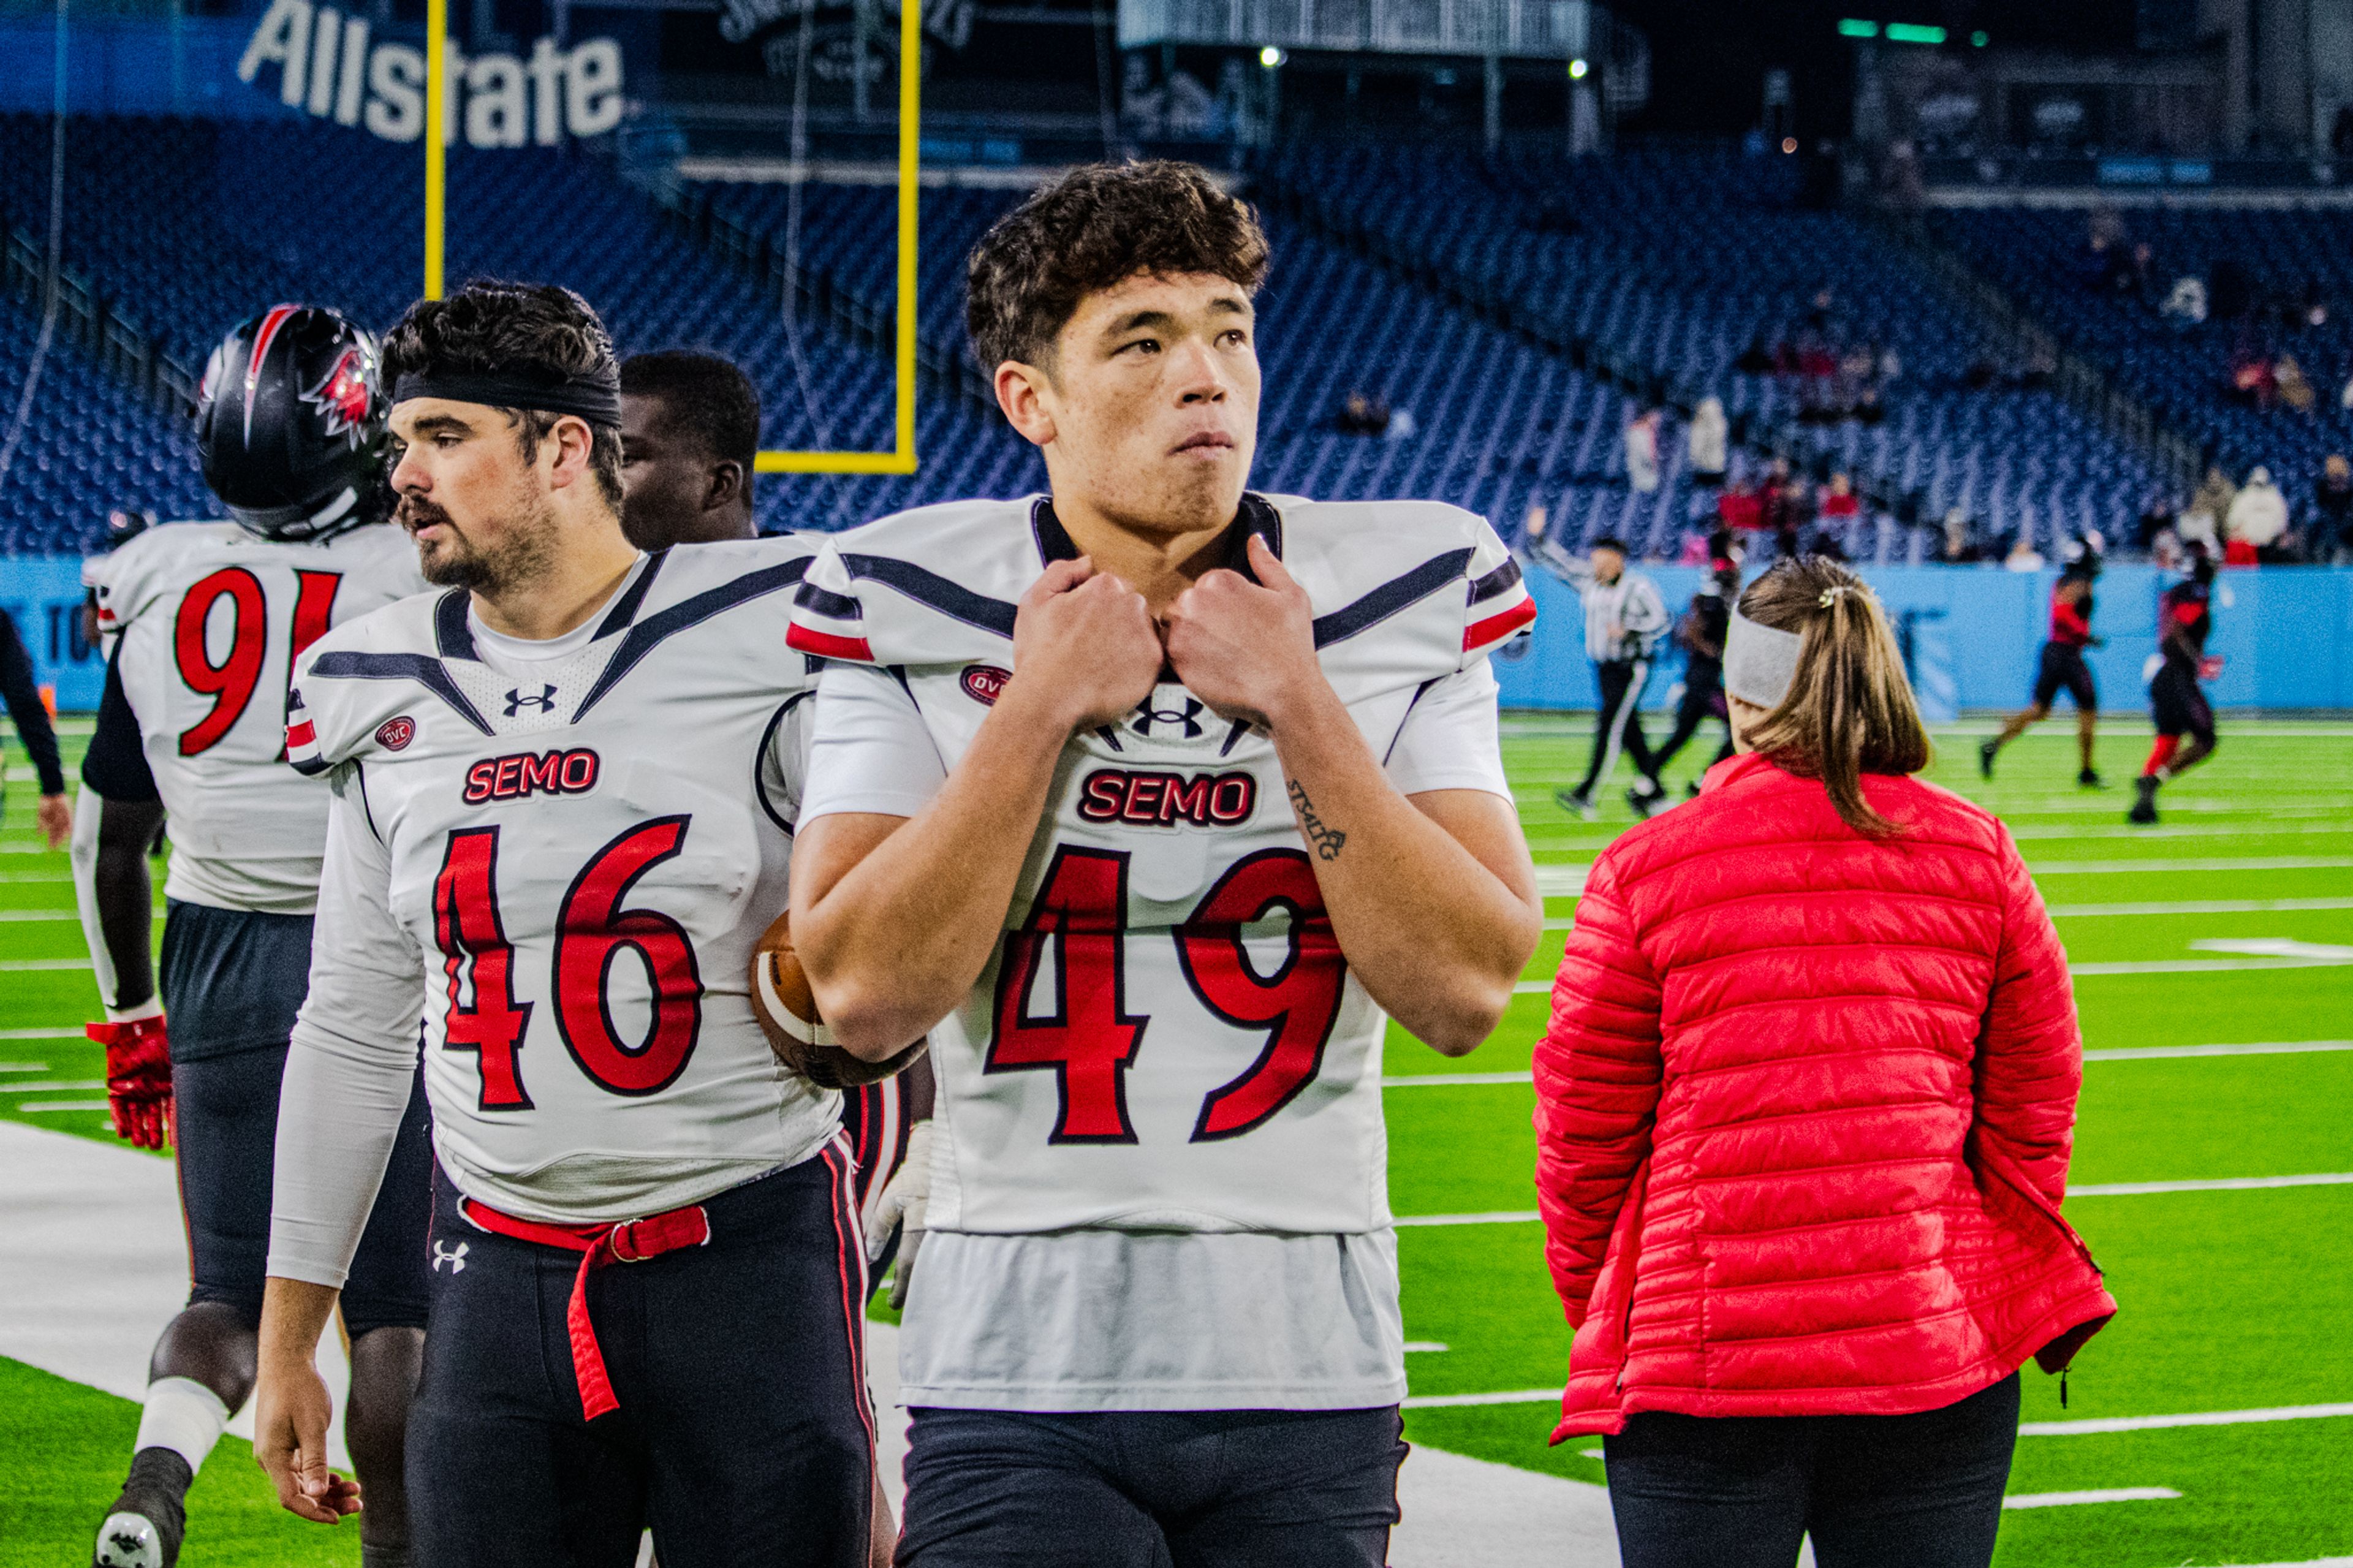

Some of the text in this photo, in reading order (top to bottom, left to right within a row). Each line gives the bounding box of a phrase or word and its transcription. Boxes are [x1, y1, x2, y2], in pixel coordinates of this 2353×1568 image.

[238, 0, 623, 148] Allstate
[384, 725, 406, 743] OVC
[462, 748, 600, 806] SEMO
[1076, 768, 1256, 828] SEMO
[431, 813, 705, 1112] 46
[982, 843, 1348, 1146] 49
